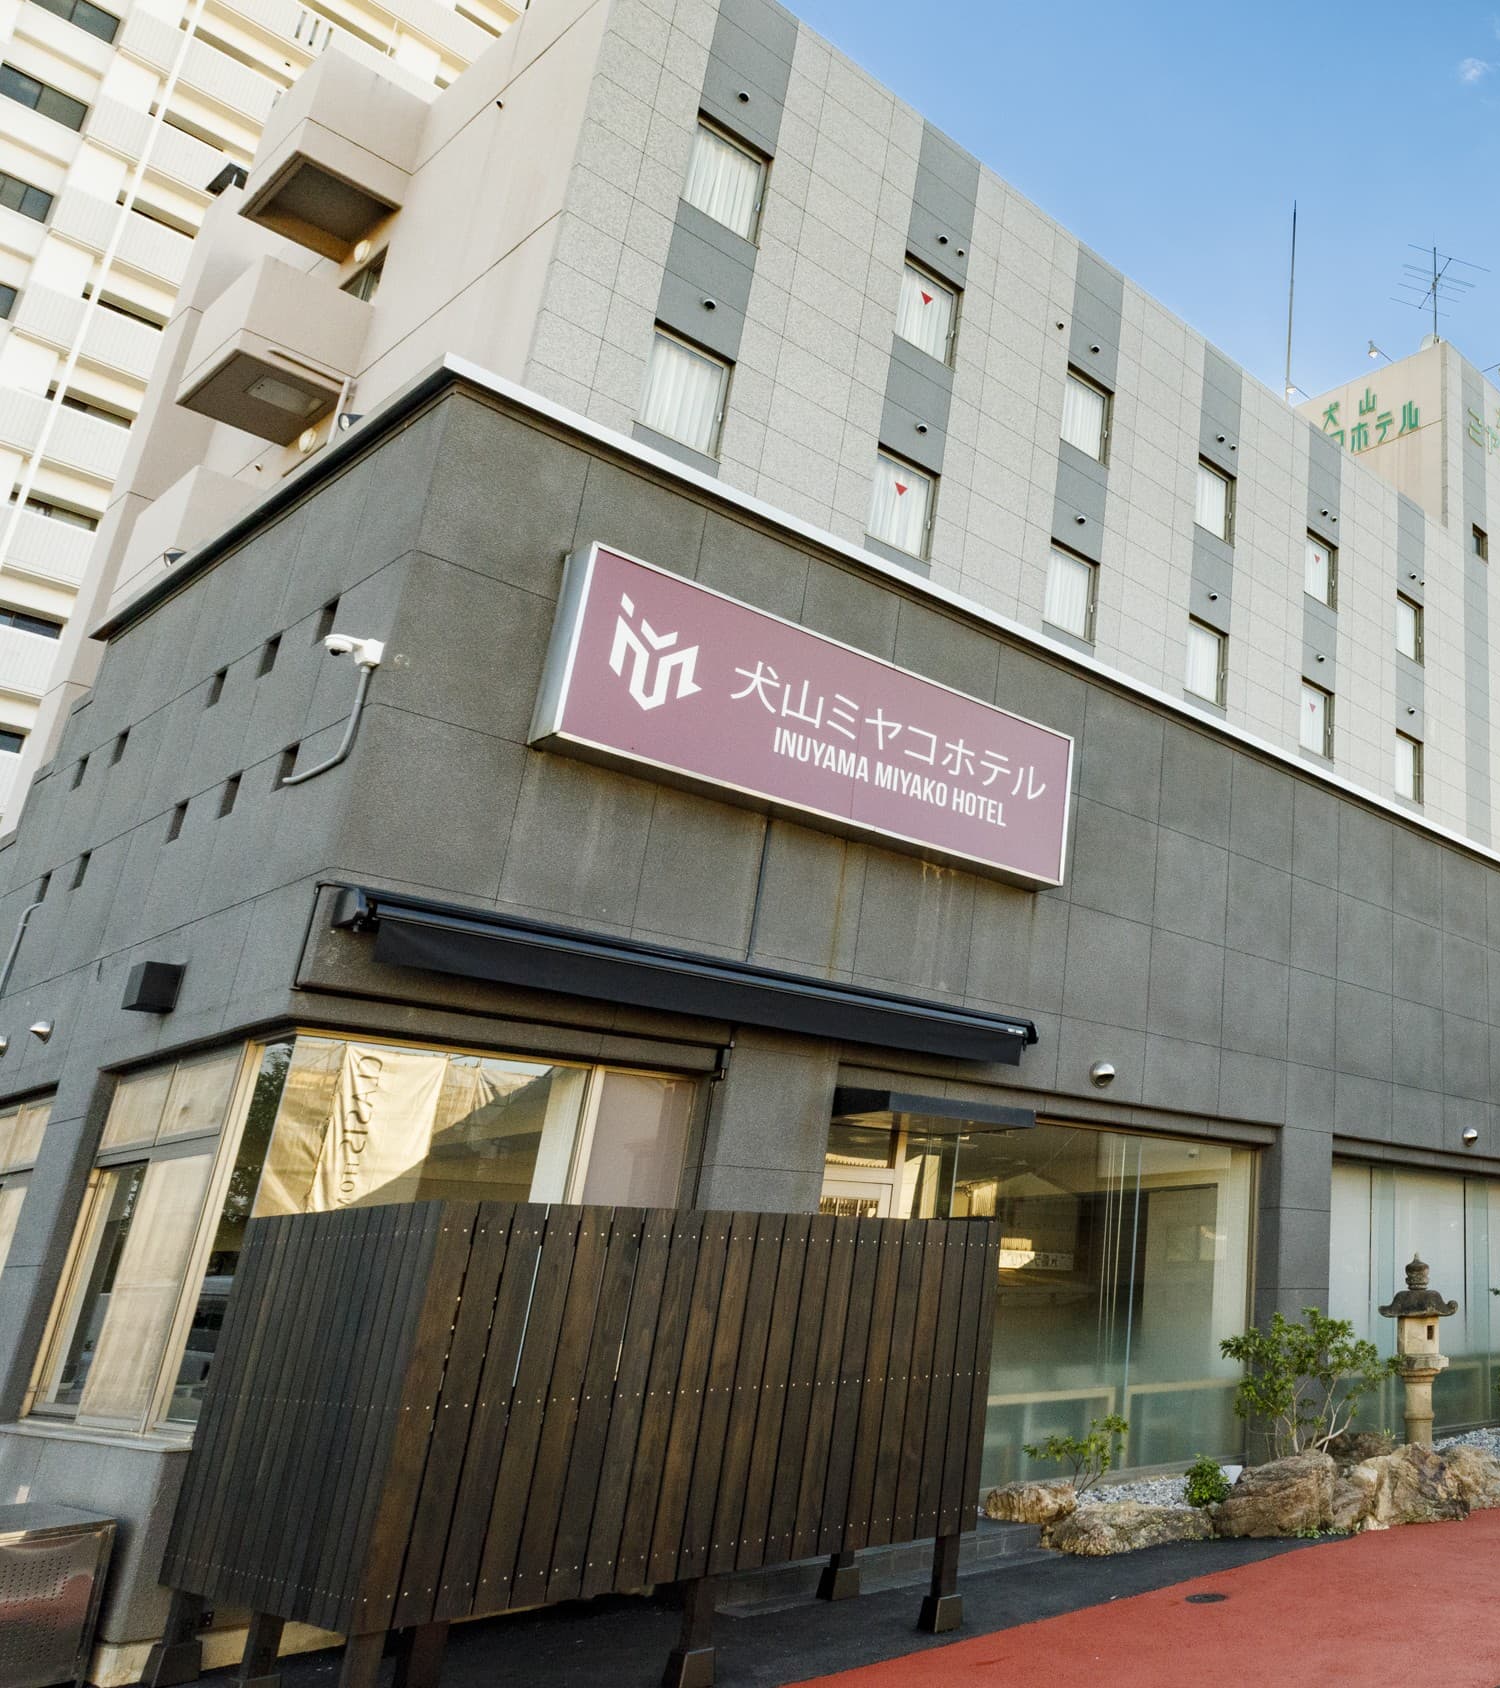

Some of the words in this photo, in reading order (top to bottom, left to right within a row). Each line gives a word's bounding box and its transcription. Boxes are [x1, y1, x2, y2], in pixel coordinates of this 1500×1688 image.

[730, 660, 1046, 800] 犬山ミヤコホテル
[773, 726, 869, 783] INUYAMA
[874, 761, 948, 807] MIYAKO
[952, 787, 1007, 827] HOTEL
